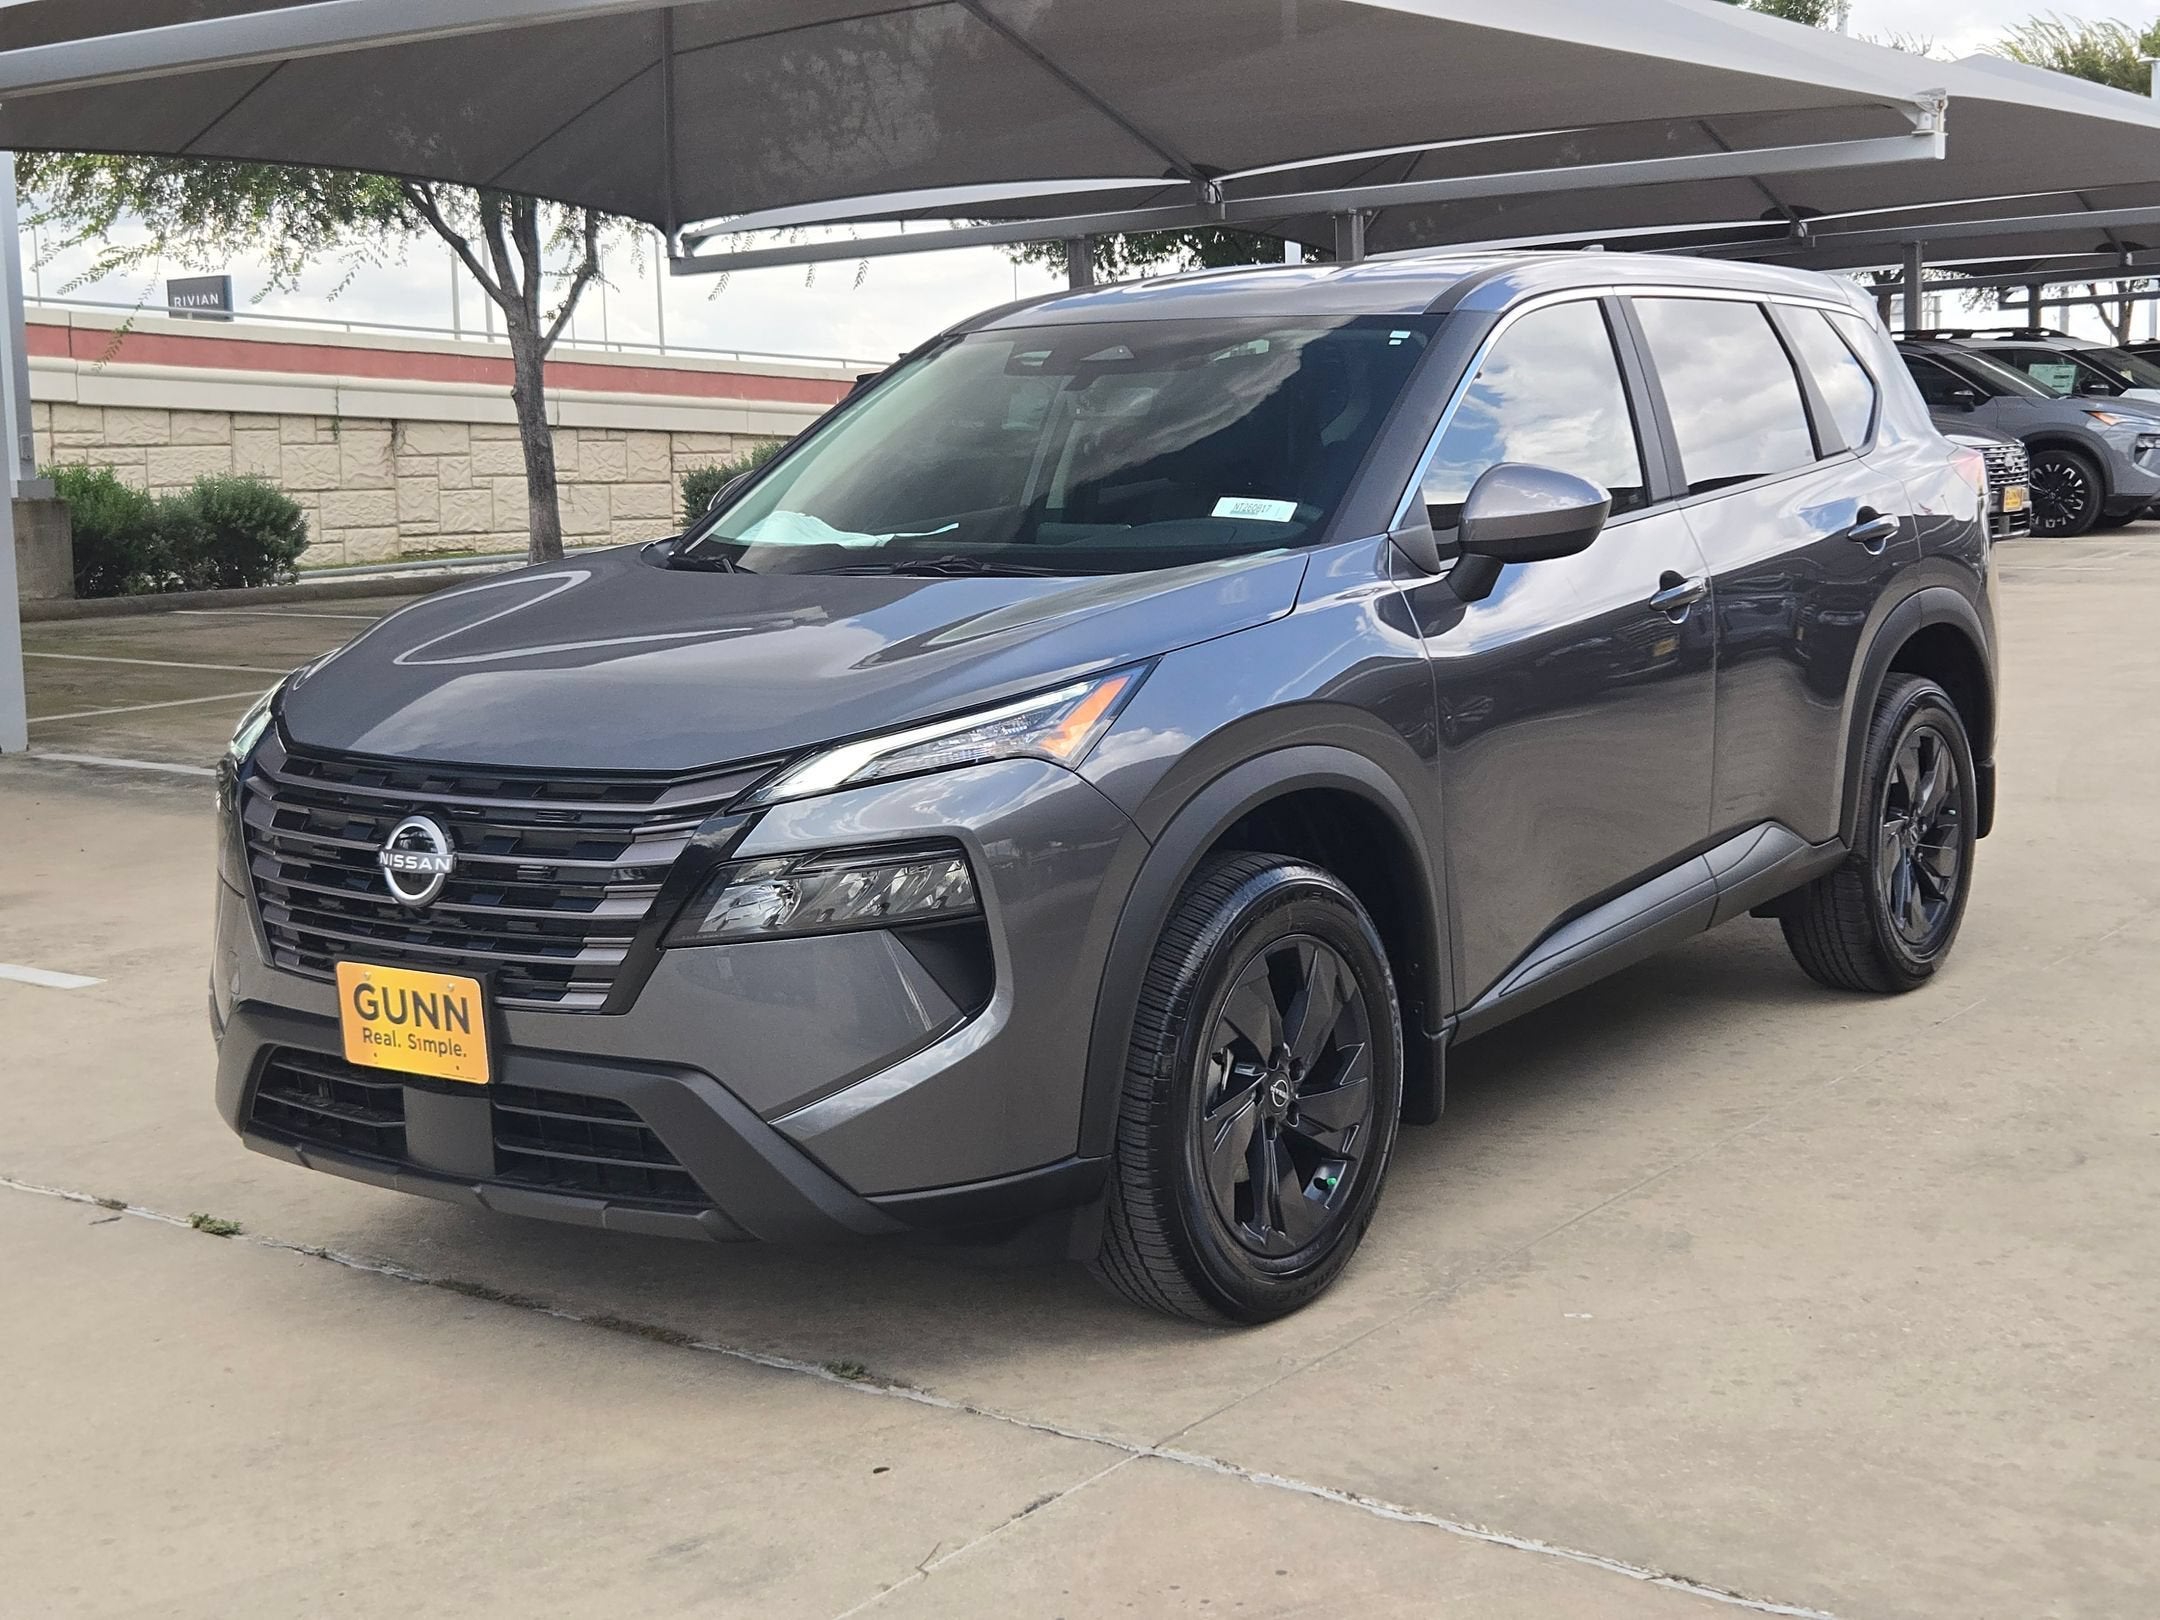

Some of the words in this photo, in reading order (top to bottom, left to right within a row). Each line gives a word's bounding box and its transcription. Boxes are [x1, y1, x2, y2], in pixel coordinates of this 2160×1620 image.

[174, 293, 219, 308] RIVIAN
[379, 851, 450, 871] NISSAN
[353, 982, 471, 1035] GUNN
[362, 1027, 401, 1049] Real.
[407, 1033, 467, 1058] Simple.
